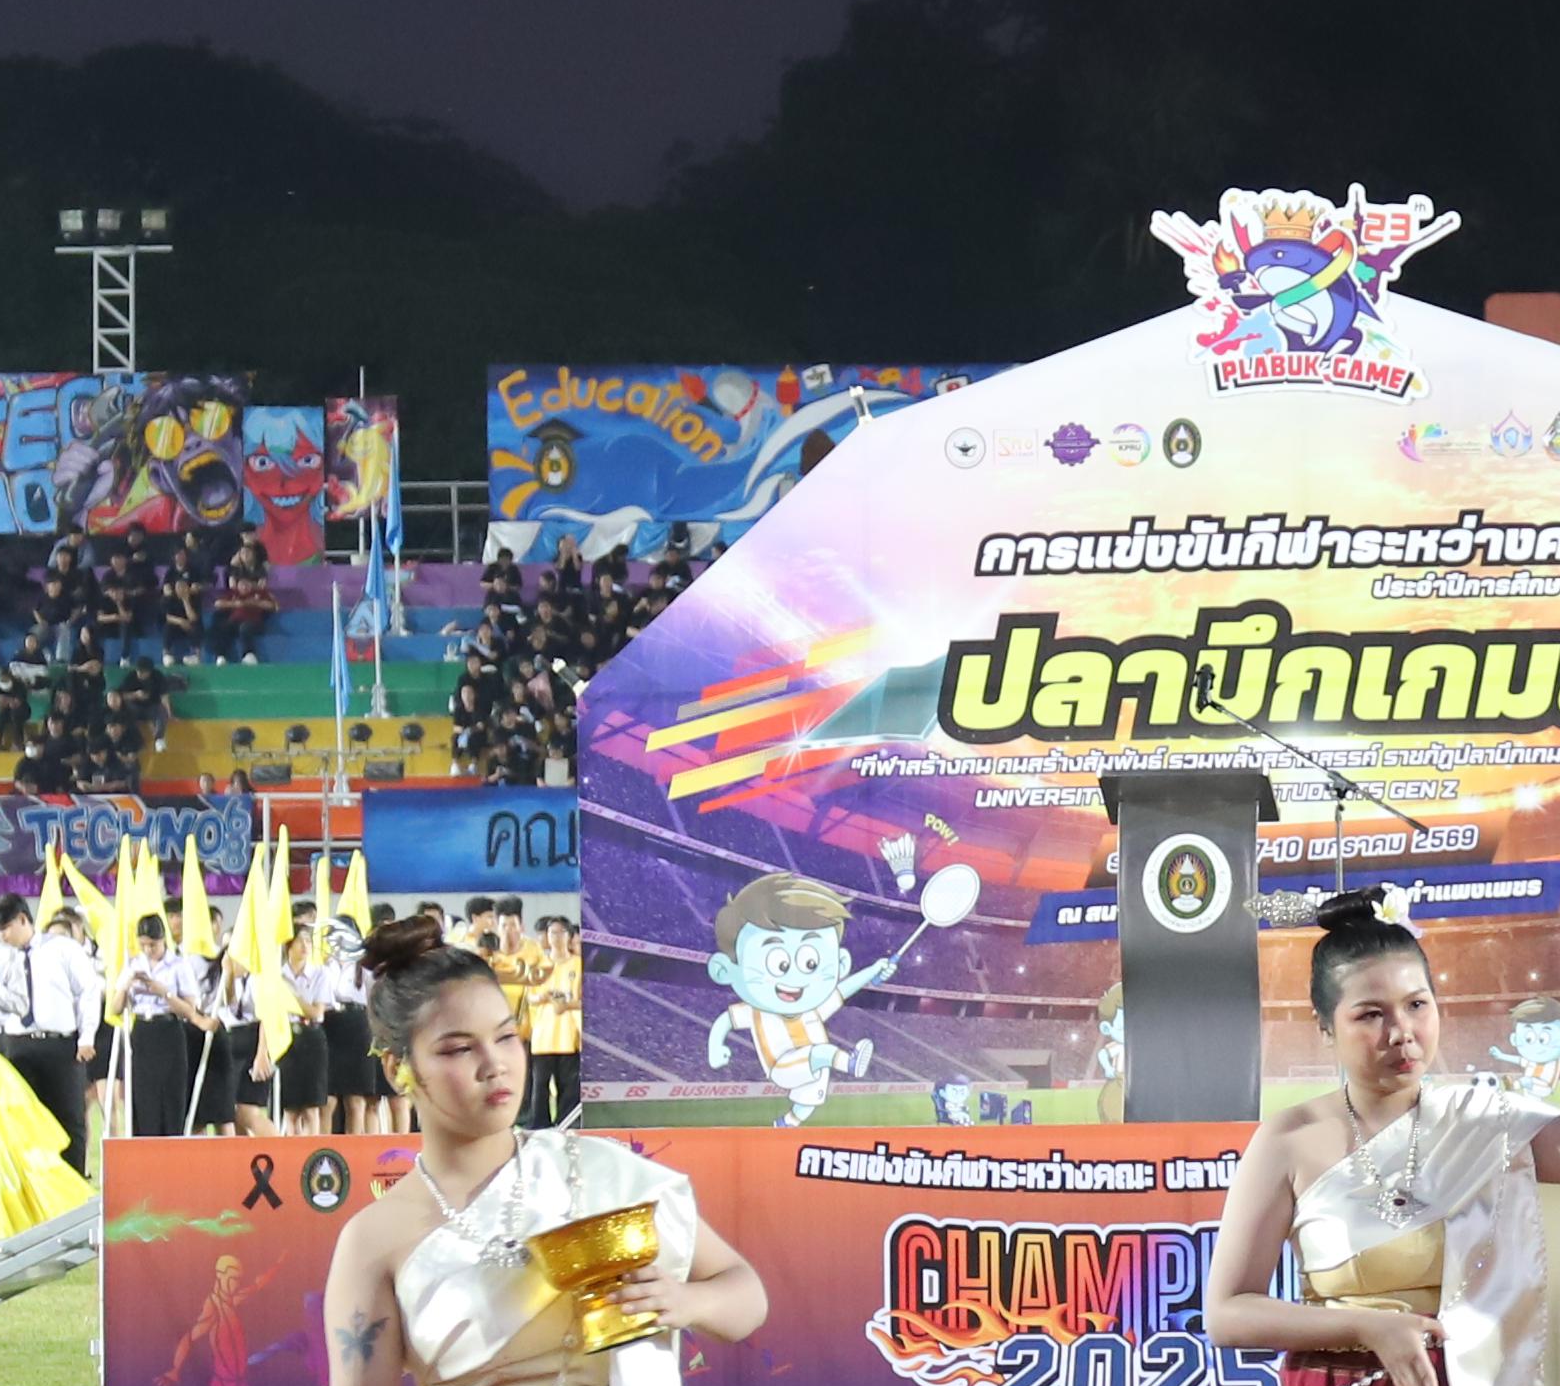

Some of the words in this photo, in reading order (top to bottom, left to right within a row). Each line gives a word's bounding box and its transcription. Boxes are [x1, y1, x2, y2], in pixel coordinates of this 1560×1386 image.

[1332, 356, 1408, 391] GAME
[1388, 780, 1439, 800] GEN
[1443, 780, 1460, 799] Z
[924, 812, 959, 846] POW!
[1412, 825, 1478, 853] 2569
[669, 1085, 749, 1097] BUSINESS
[798, 1142, 1156, 1192] การแข่งขันกีฬาระหว่างคณะ
